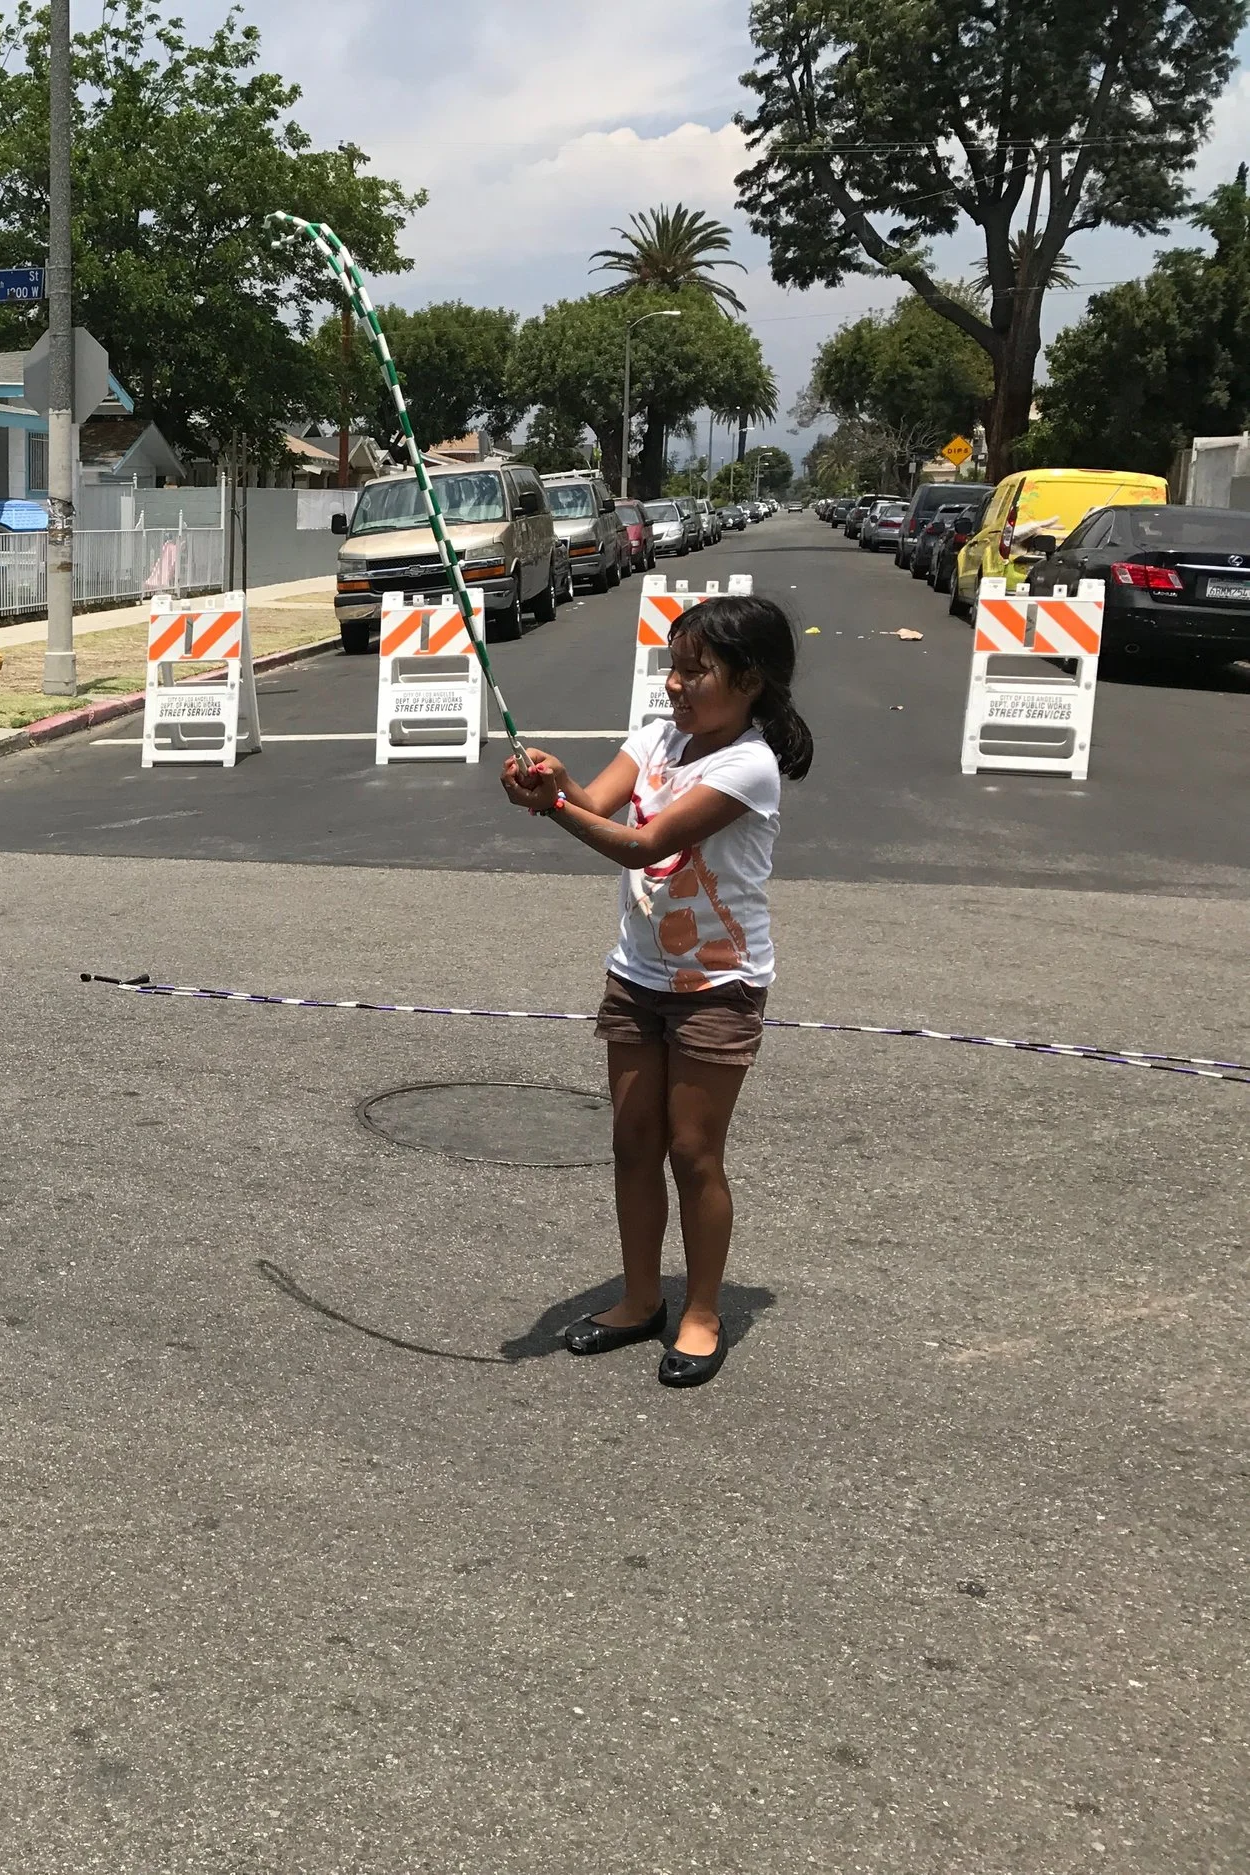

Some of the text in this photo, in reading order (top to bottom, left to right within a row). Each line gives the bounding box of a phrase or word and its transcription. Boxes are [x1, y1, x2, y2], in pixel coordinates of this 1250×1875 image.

[29, 271, 39, 281] St
[31, 286, 39, 297] W
[947, 447, 969, 455] DIPS
[395, 703, 463, 712] STREET SERVICES
[648, 699, 673, 708] STRE
[990, 700, 1008, 708] DEPT.
[1021, 701, 1045, 709] PUBLIC
[159, 708, 221, 717] STREET SERVICES
[988, 708, 1072, 720] STREET SERVICES
